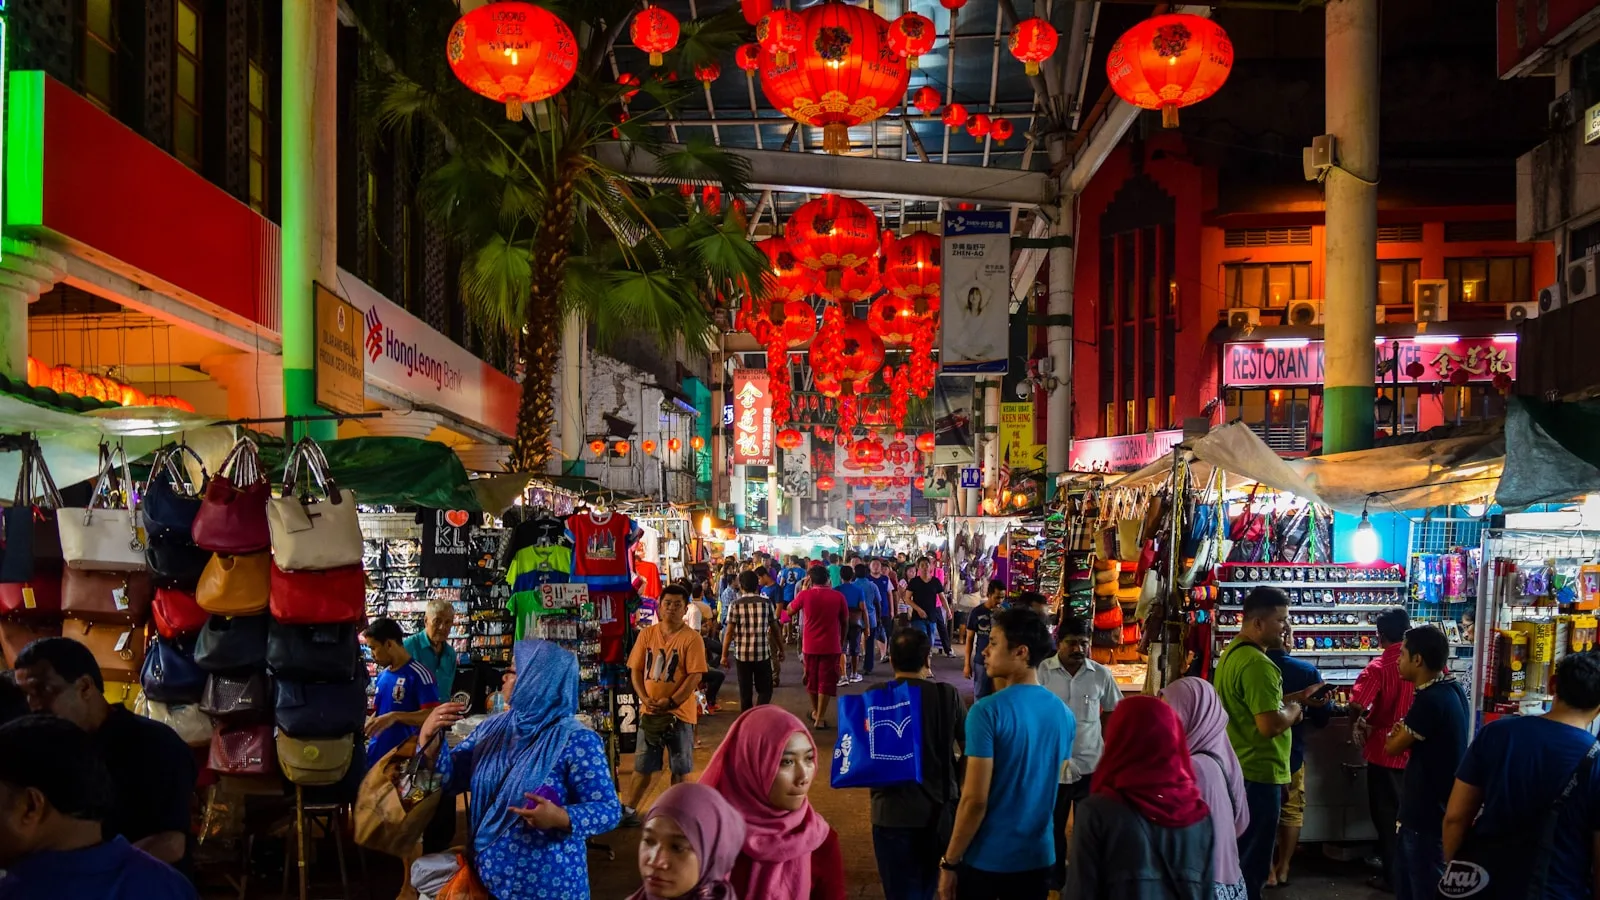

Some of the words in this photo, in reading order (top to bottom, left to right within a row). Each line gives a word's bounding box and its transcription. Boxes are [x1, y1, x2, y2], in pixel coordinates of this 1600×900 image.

[1232, 346, 1309, 379] RESTORAN
[444, 360, 463, 395] Bank
[1001, 413, 1016, 423] KEEN
[1018, 413, 1031, 423] HING
[434, 526, 465, 547] KL
[544, 594, 554, 608] 3
[571, 593, 588, 607] 15
[617, 694, 634, 705] USA
[618, 704, 637, 734] 2
